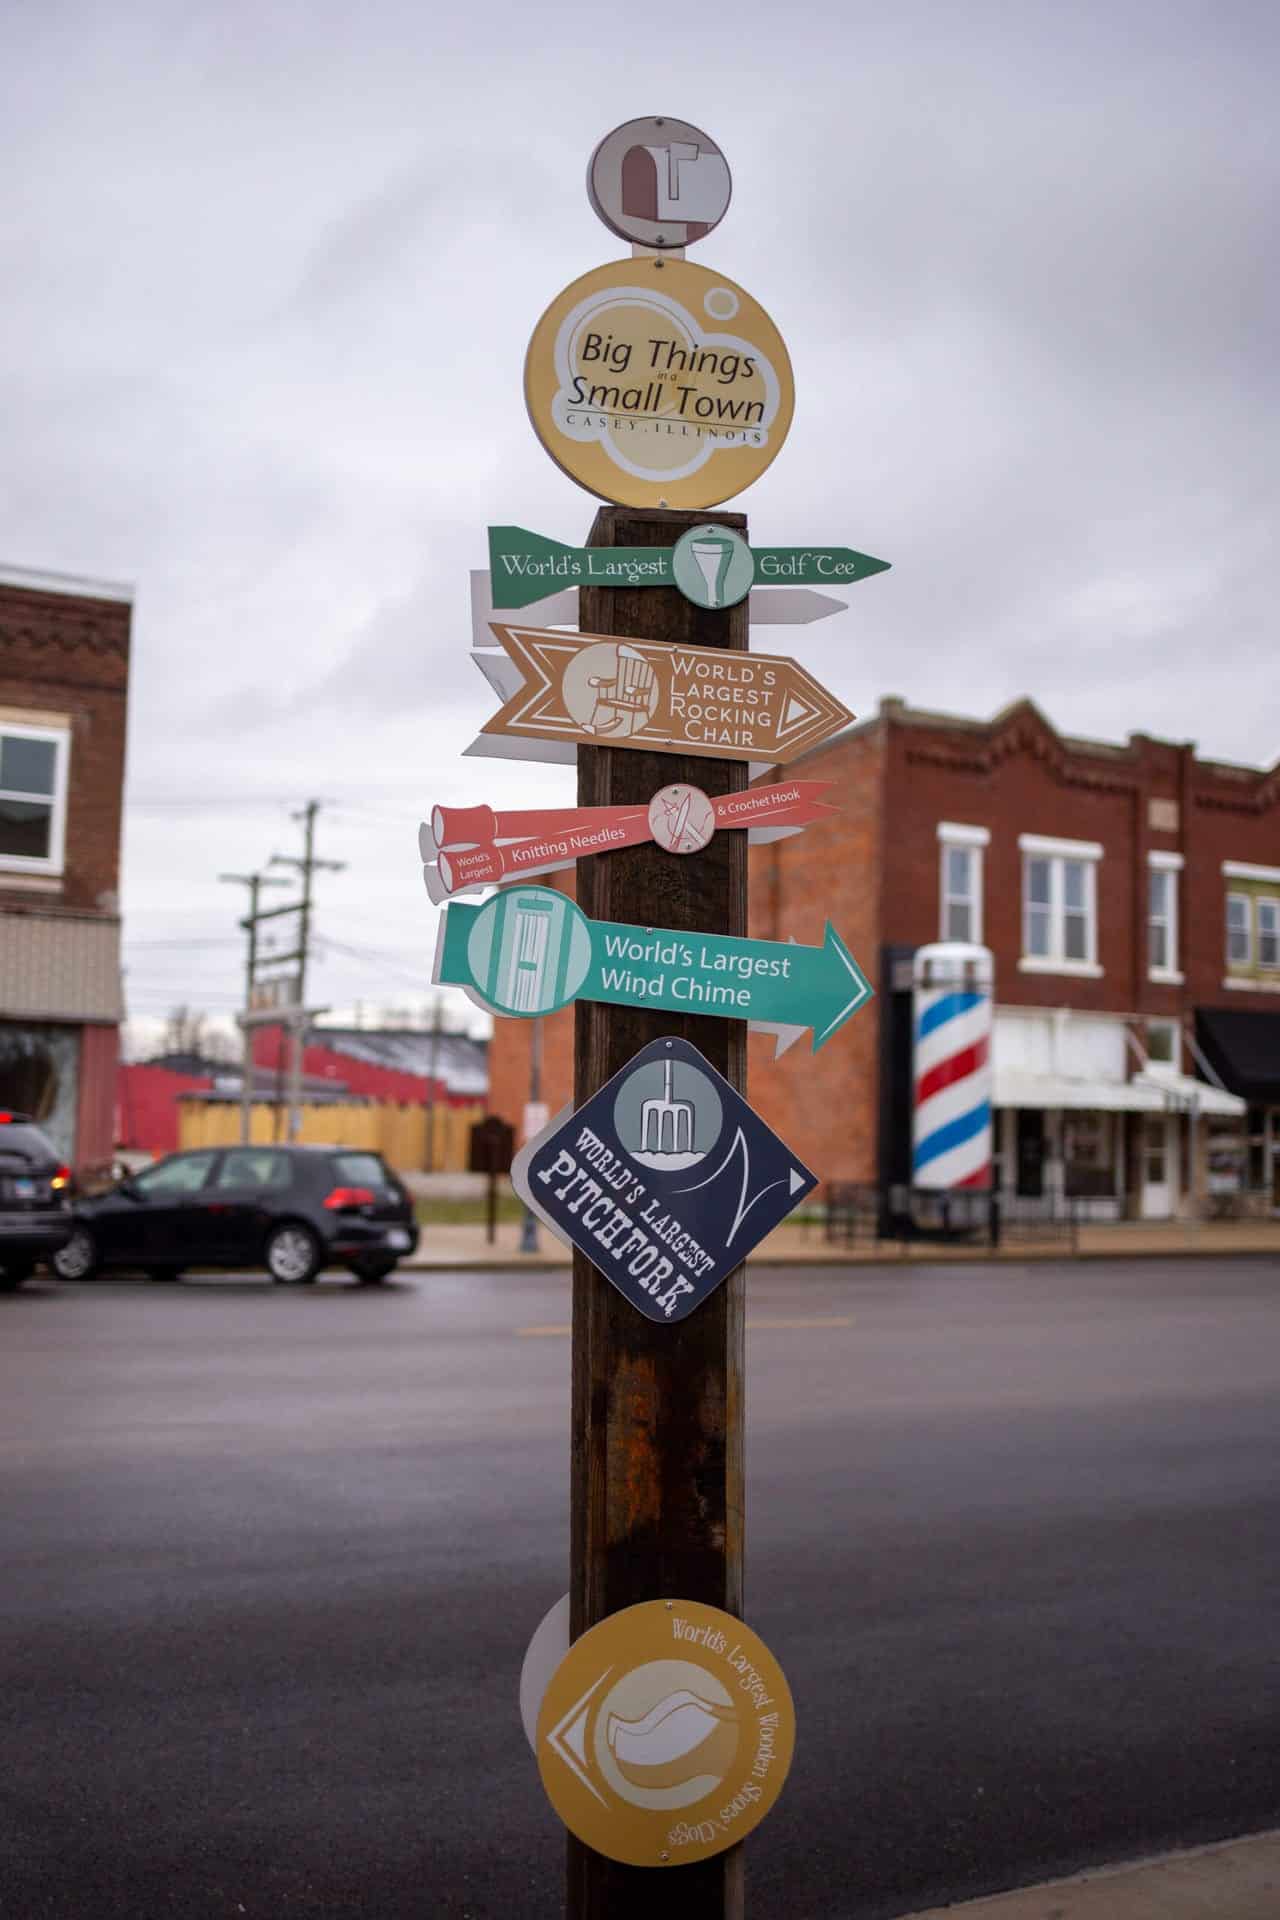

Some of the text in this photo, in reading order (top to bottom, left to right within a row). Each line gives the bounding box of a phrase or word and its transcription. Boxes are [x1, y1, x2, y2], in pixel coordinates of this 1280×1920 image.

[582, 333, 755, 385] Big Things
[568, 376, 765, 423] Small Town
[500, 552, 855, 582] World's Largest Golf Tee
[670, 654, 776, 686] WORLD'S
[670, 675, 773, 706] LARGEST
[670, 696, 771, 728] ROCKING
[684, 719, 754, 746] CHAIR
[718, 786, 801, 816] & Crochet Hook
[456, 854, 490, 869] World's
[511, 828, 626, 863] Knitting Needles
[459, 864, 494, 881] Largest
[605, 935, 791, 980] World's Largest
[601, 967, 751, 1007] Wind Chime
[575, 1127, 715, 1277] WORLD'S LARGEST
[537, 1149, 696, 1312] PITCHFORK
[726, 1645, 773, 1710] Largest
[751, 1711, 780, 1778] Wooden
